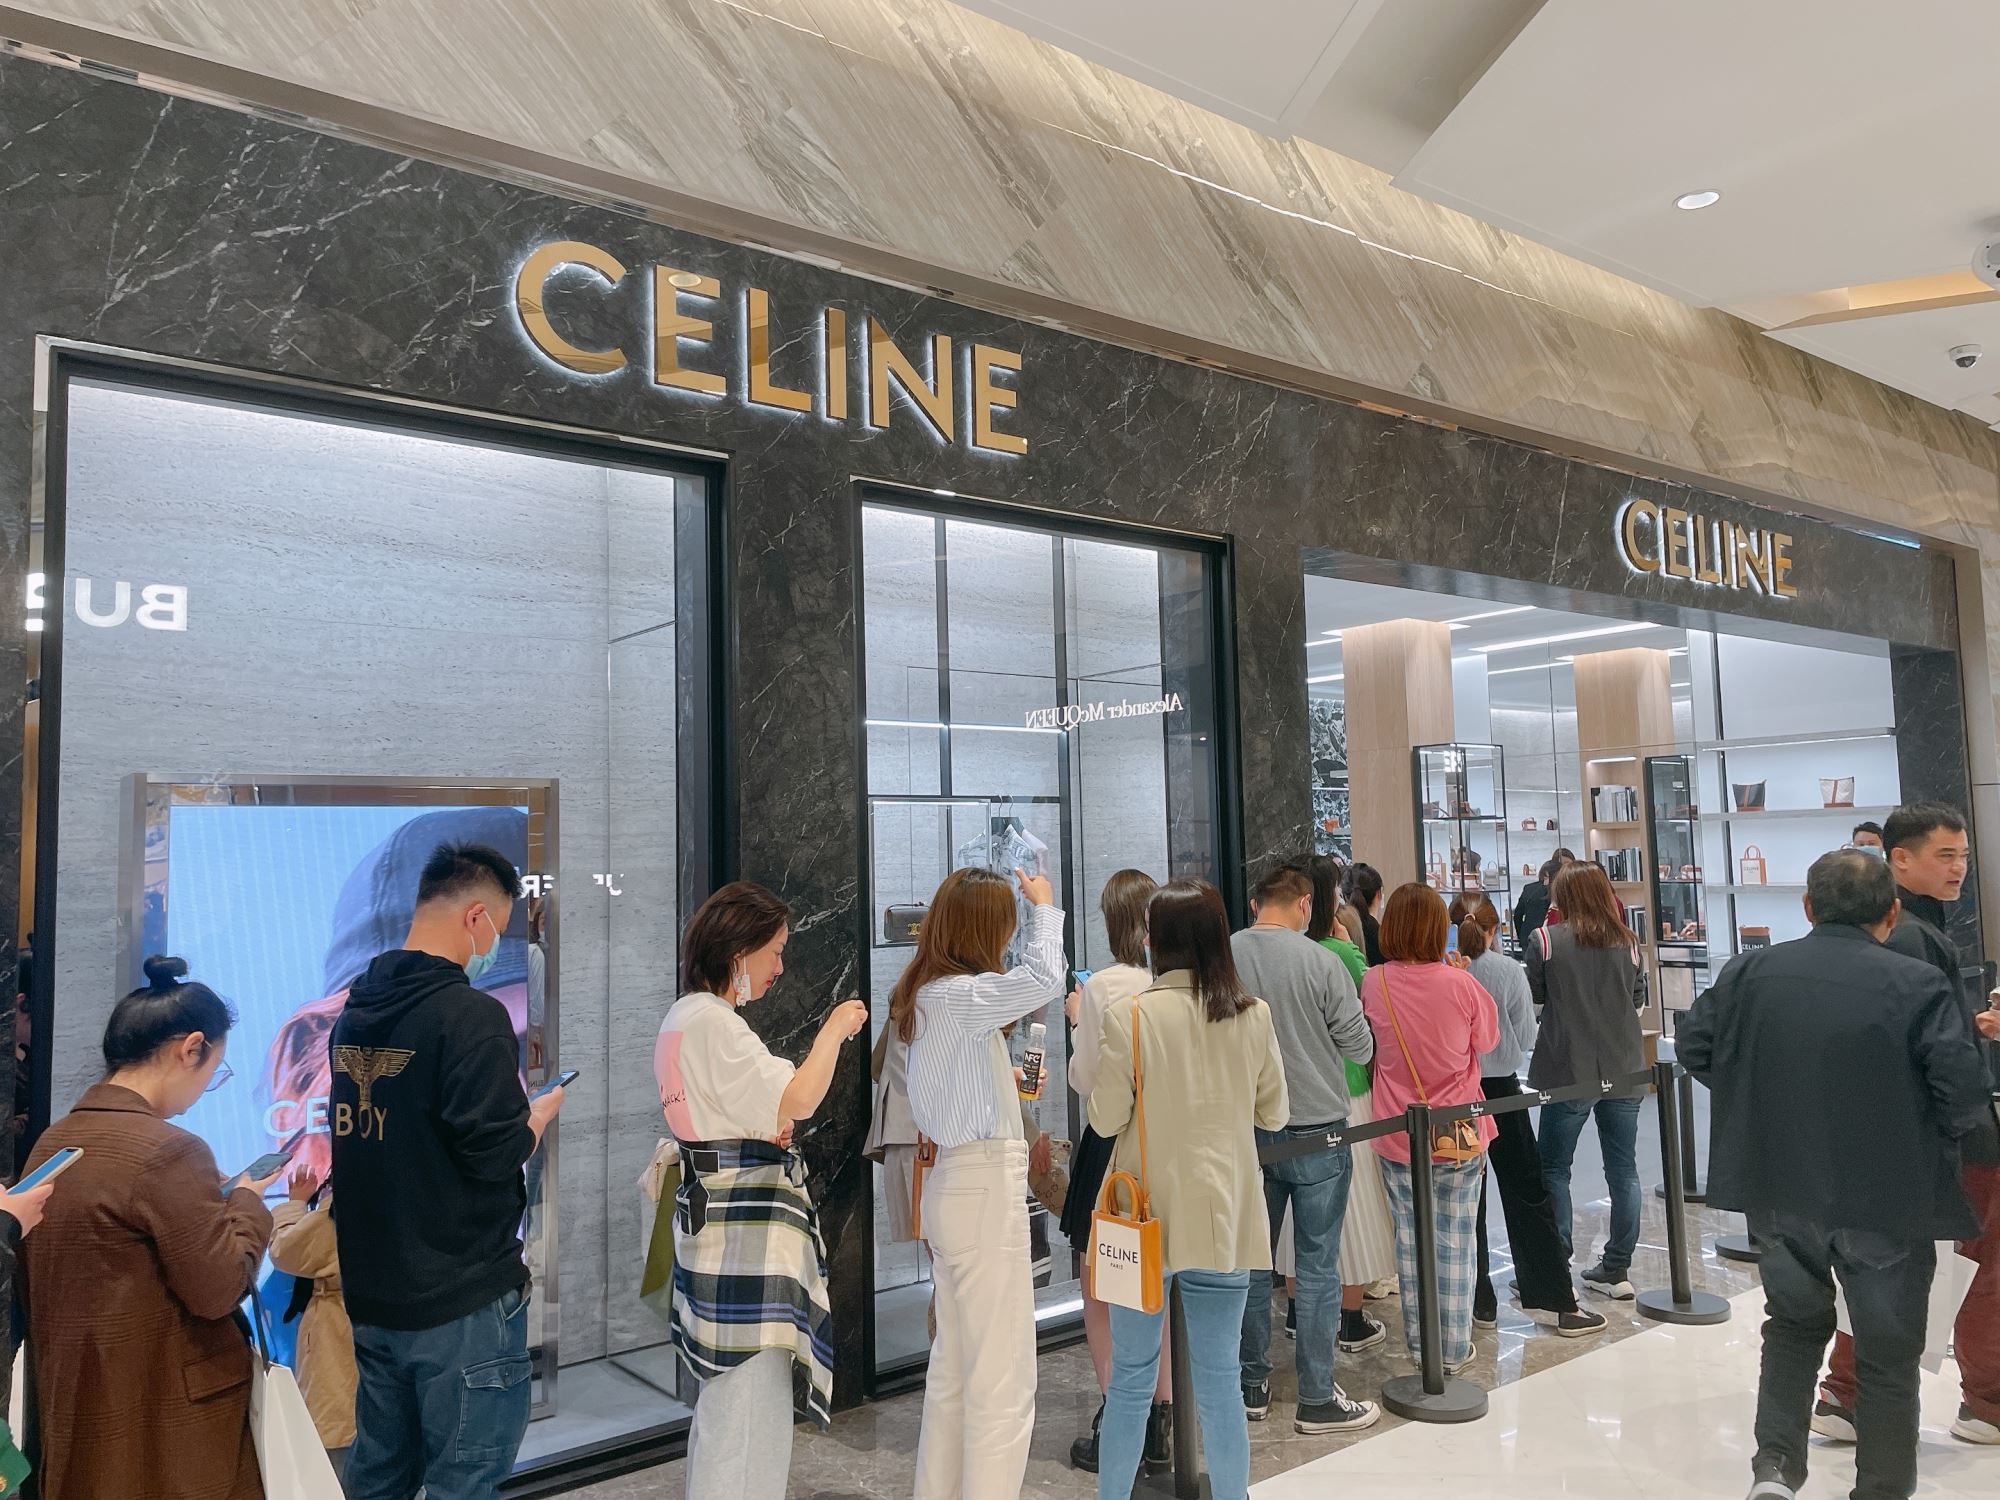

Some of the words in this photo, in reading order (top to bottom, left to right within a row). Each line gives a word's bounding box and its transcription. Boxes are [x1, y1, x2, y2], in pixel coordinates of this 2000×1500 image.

[514, 240, 1029, 456] CELINE
[1621, 498, 1798, 599] CELINE
[335, 1102, 388, 1141] BOY
[1098, 1242, 1139, 1265] CELINE
[1110, 1262, 1124, 1270] PARIS
